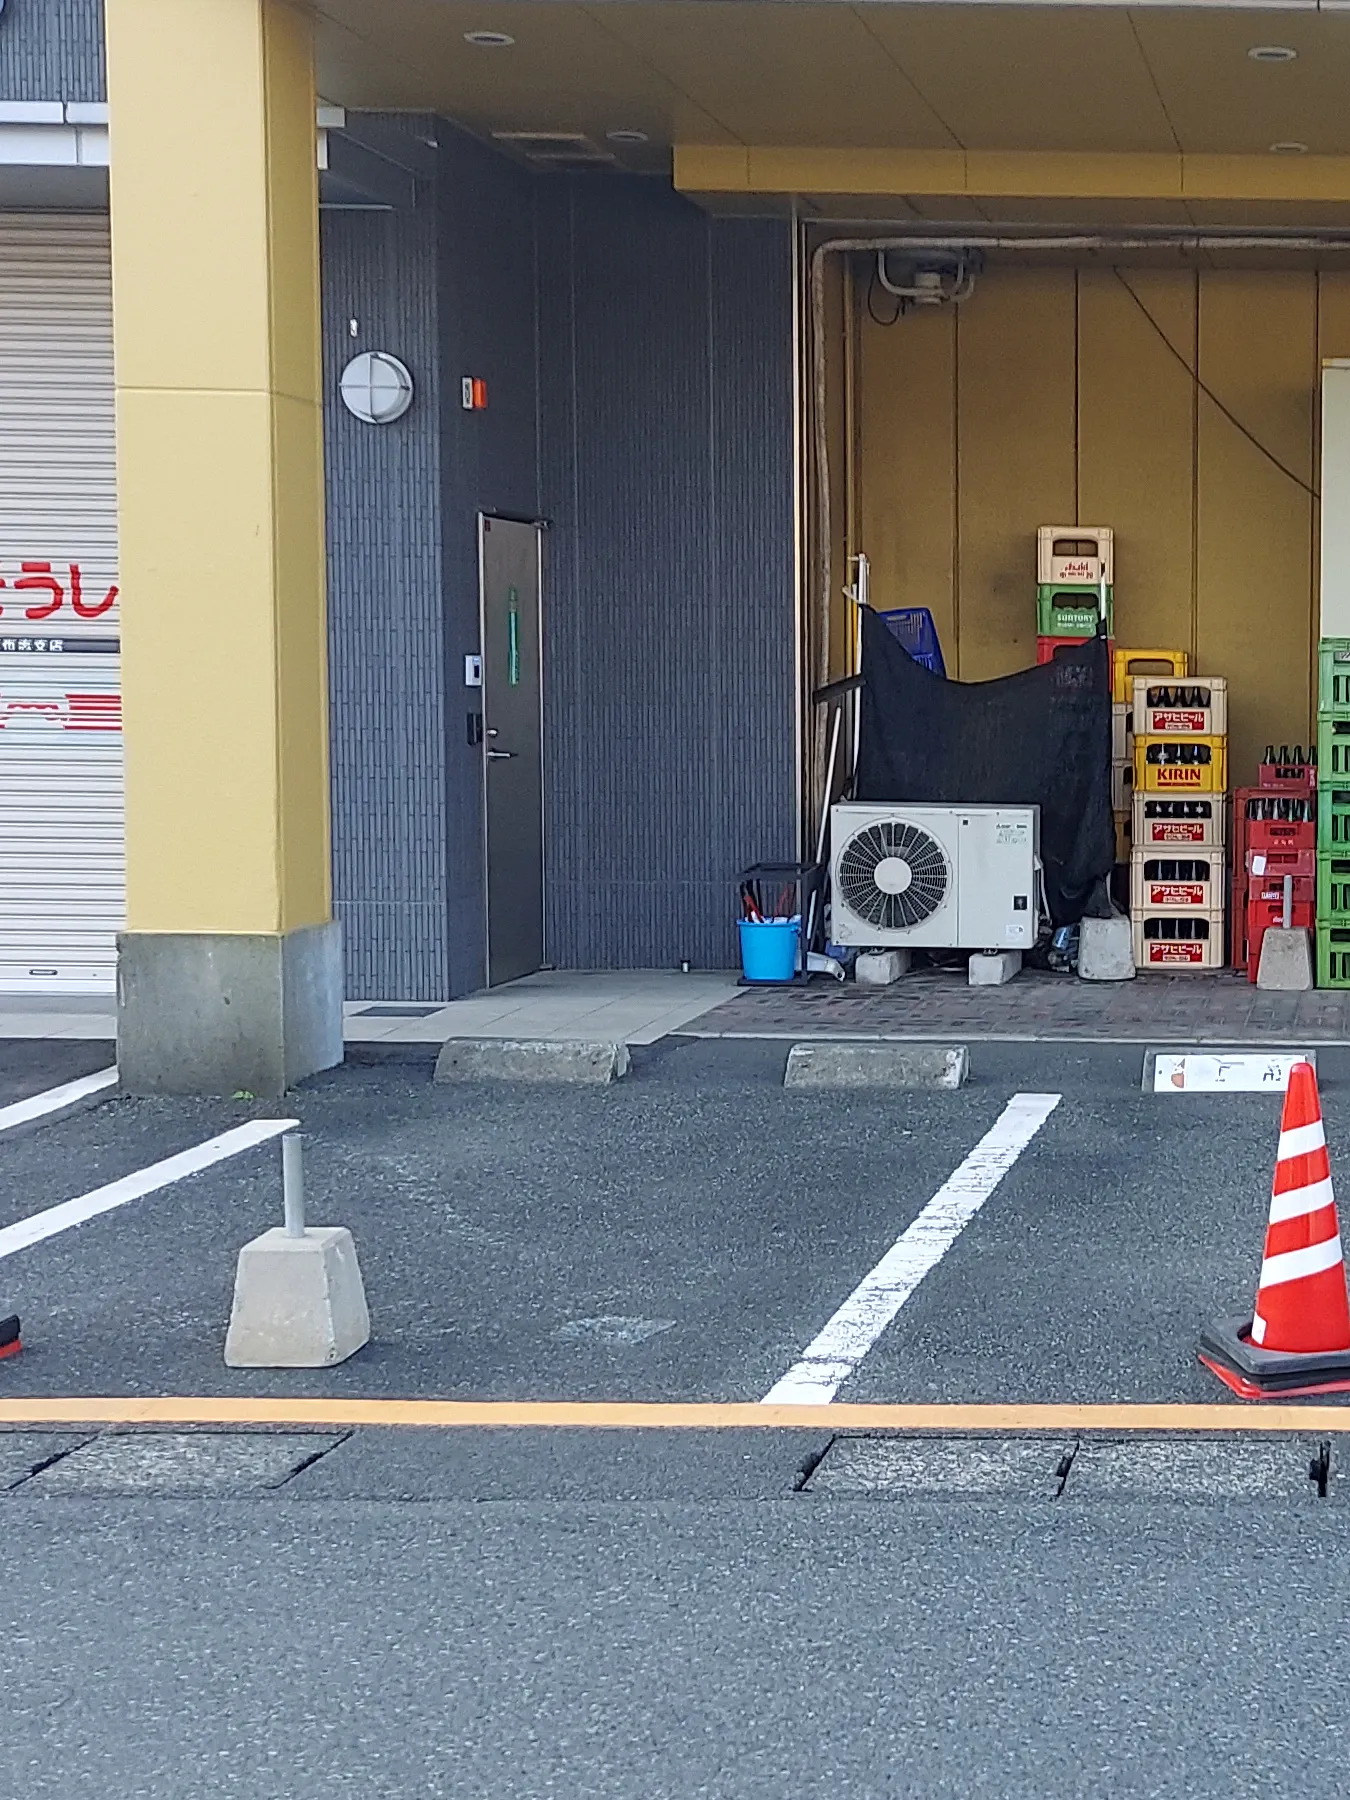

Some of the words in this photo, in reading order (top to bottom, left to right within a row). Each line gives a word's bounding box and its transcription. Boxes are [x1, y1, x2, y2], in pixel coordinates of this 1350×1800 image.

[0, 562, 119, 619] うし
[0, 638, 64, 651] 布志支店
[1154, 712, 1204, 723] アサヒビール
[1157, 768, 1201, 780] KIRIN
[1153, 823, 1203, 834] アサヒビール
[1152, 885, 1203, 897] アサヒビール
[1151, 944, 1202, 955] アサヒビール
